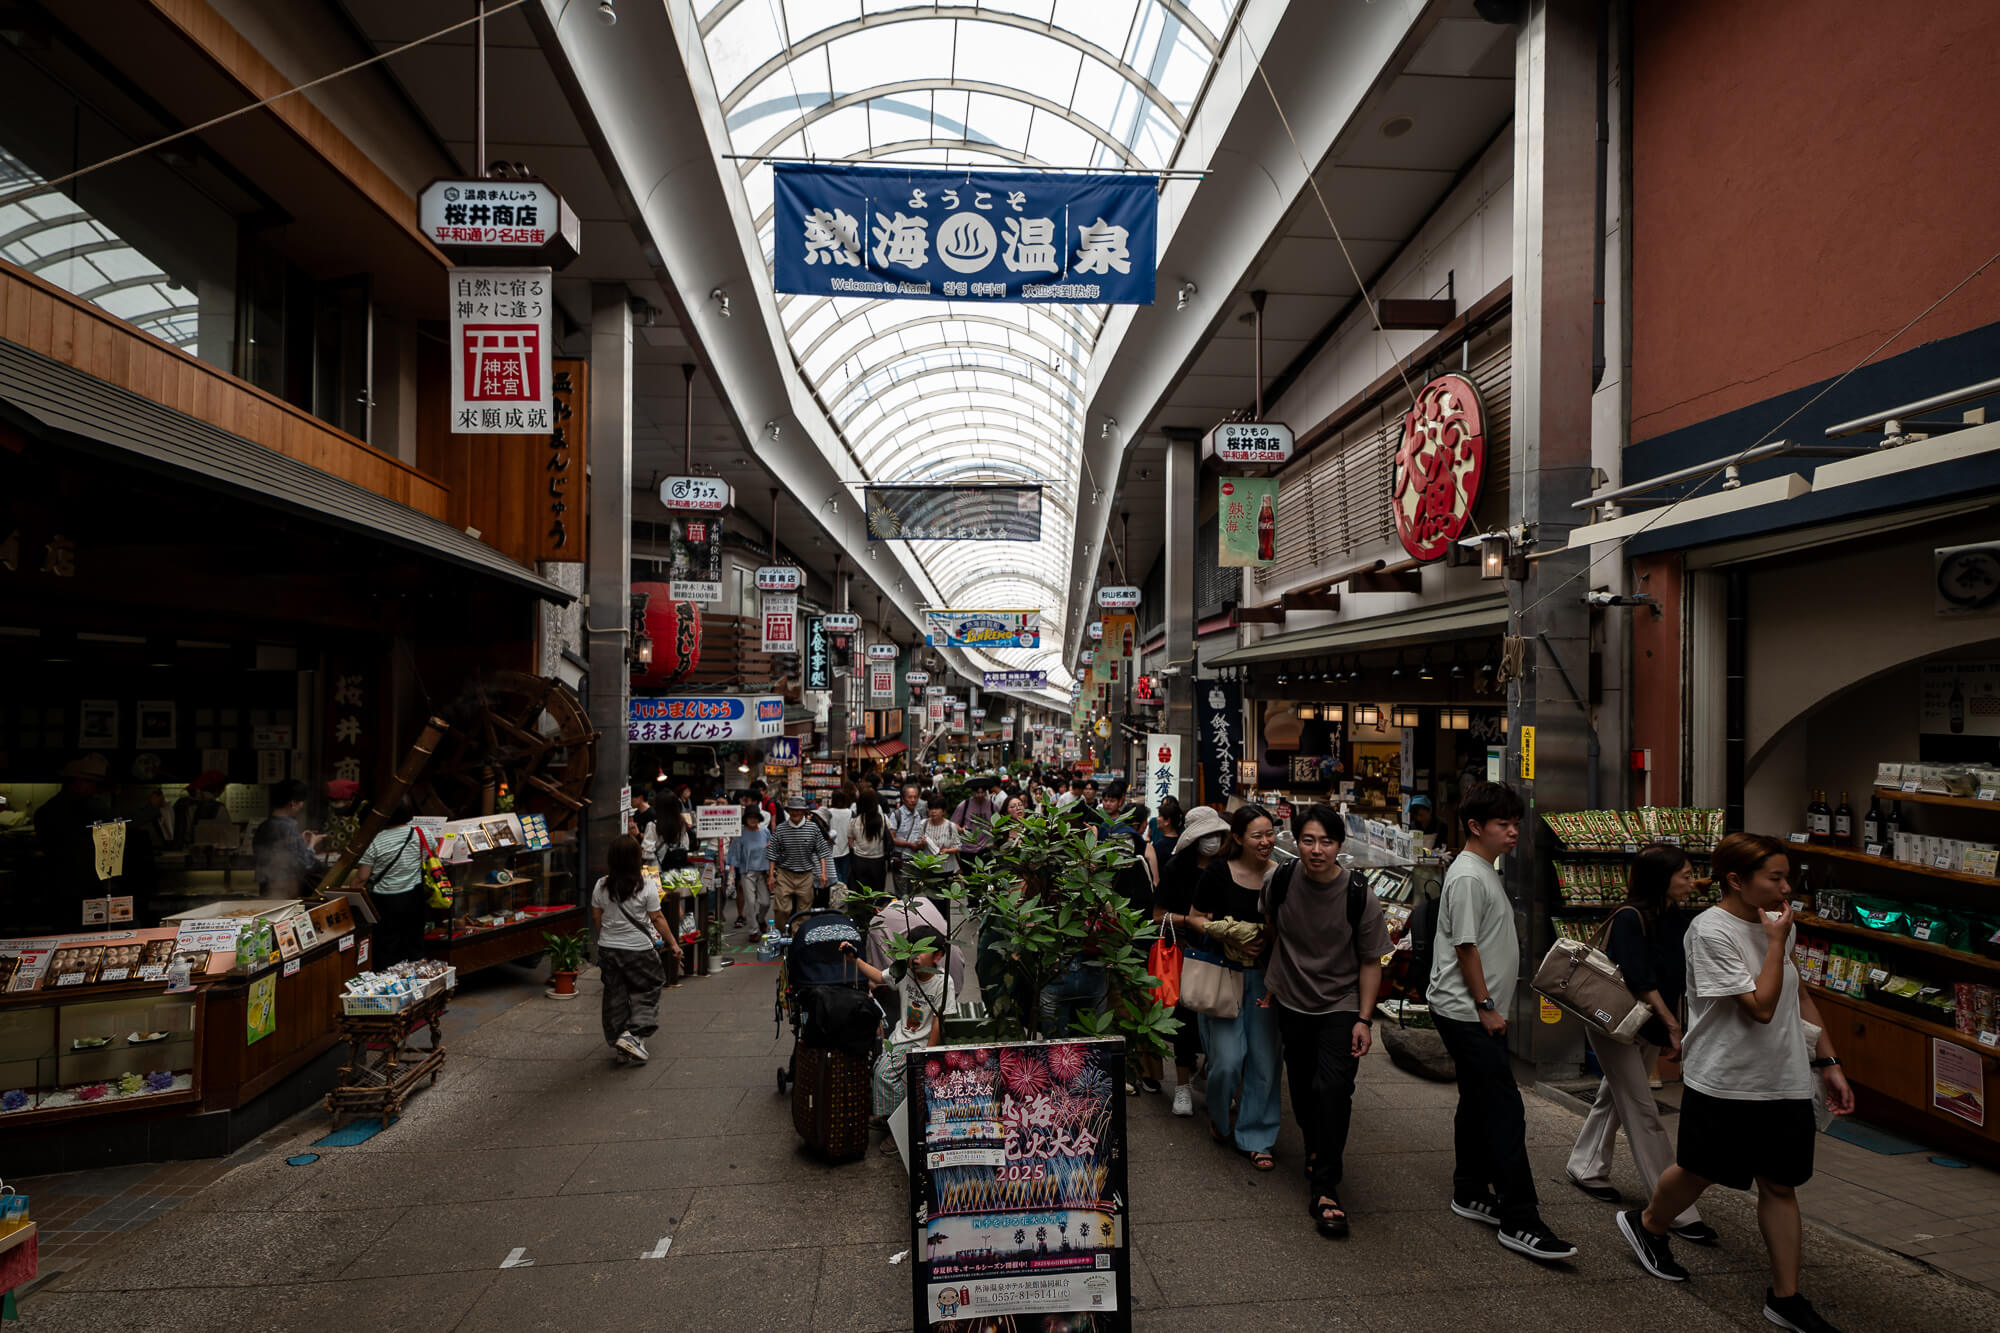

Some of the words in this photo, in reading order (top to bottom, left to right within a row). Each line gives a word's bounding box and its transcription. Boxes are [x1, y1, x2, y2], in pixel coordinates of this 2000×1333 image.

[464, 189, 537, 201] 温泉まんじゅう
[908, 188, 1027, 211] ようこそ
[444, 204, 537, 226] 桜井商店
[435, 227, 545, 243] 平和通り名店街
[803, 208, 930, 270] 熱海
[1001, 216, 1133, 275] 温泉
[457, 279, 543, 297] 自然に宿る
[831, 278, 882, 293] Welcome
[884, 281, 897, 293] to
[898, 281, 931, 295] Atami
[970, 282, 1007, 298] 아타미
[457, 301, 543, 318] 神々に逢う
[1240, 427, 1268, 437] ひもの
[1227, 438, 1280, 450] 桜井商店
[1223, 451, 1284, 460] 平和通り名店街
[810, 620, 826, 687] お食事処
[949, 1070, 977, 1085] 熱海
[933, 1081, 995, 1099] 海上花火大会
[996, 1164, 1046, 1182] 2025
